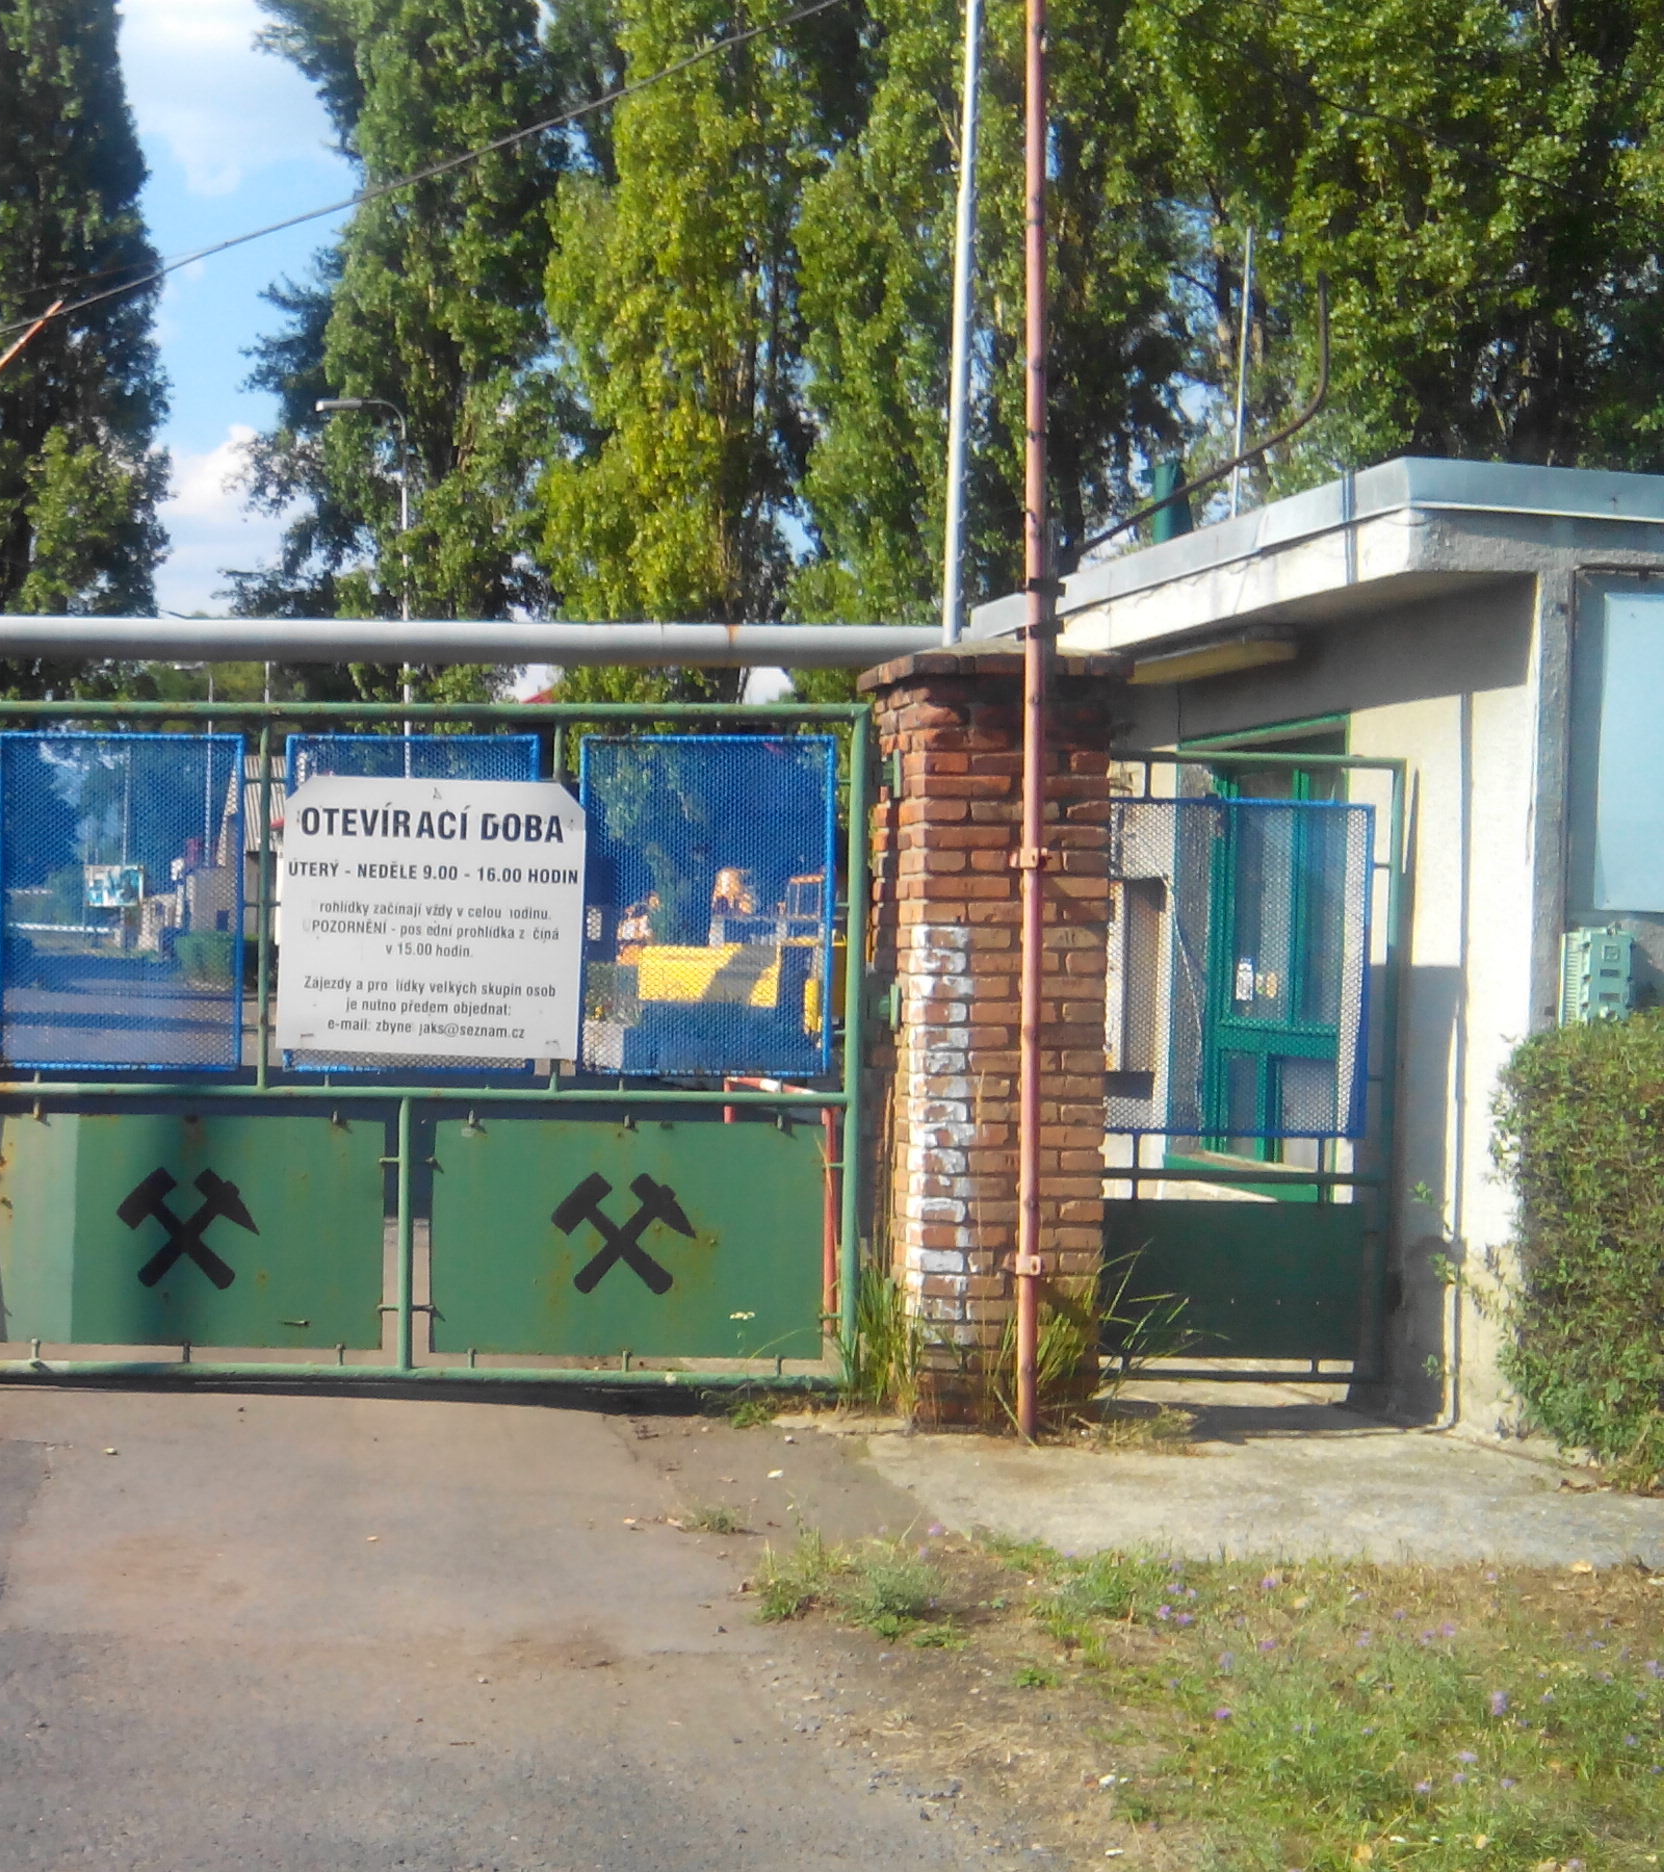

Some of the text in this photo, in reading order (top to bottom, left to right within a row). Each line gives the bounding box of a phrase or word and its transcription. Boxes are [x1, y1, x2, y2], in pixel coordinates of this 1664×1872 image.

[301, 801, 564, 843] OTEVÍRACÍ DOBA
[288, 857, 339, 877] ÚTERÝ
[357, 861, 417, 880] NEDĚLE
[422, 864, 458, 880] 9.00
[477, 866, 522, 883] 16.00
[528, 868, 578, 884] HODIN
[313, 900, 369, 916] rohlídky
[373, 902, 421, 917] začínají
[425, 904, 453, 919] vždy
[457, 907, 464, 917] v
[468, 905, 501, 918] celou
[400, 924, 453, 938] posední
[456, 925, 515, 940] prohlídka
[385, 942, 473, 957] v 15.00 hodin.
[304, 975, 556, 998] Zájezdy a prolídky velkých skupin osob
[345, 996, 511, 1016] je nutno předem objednat:
[327, 1018, 372, 1031] e-mail:
